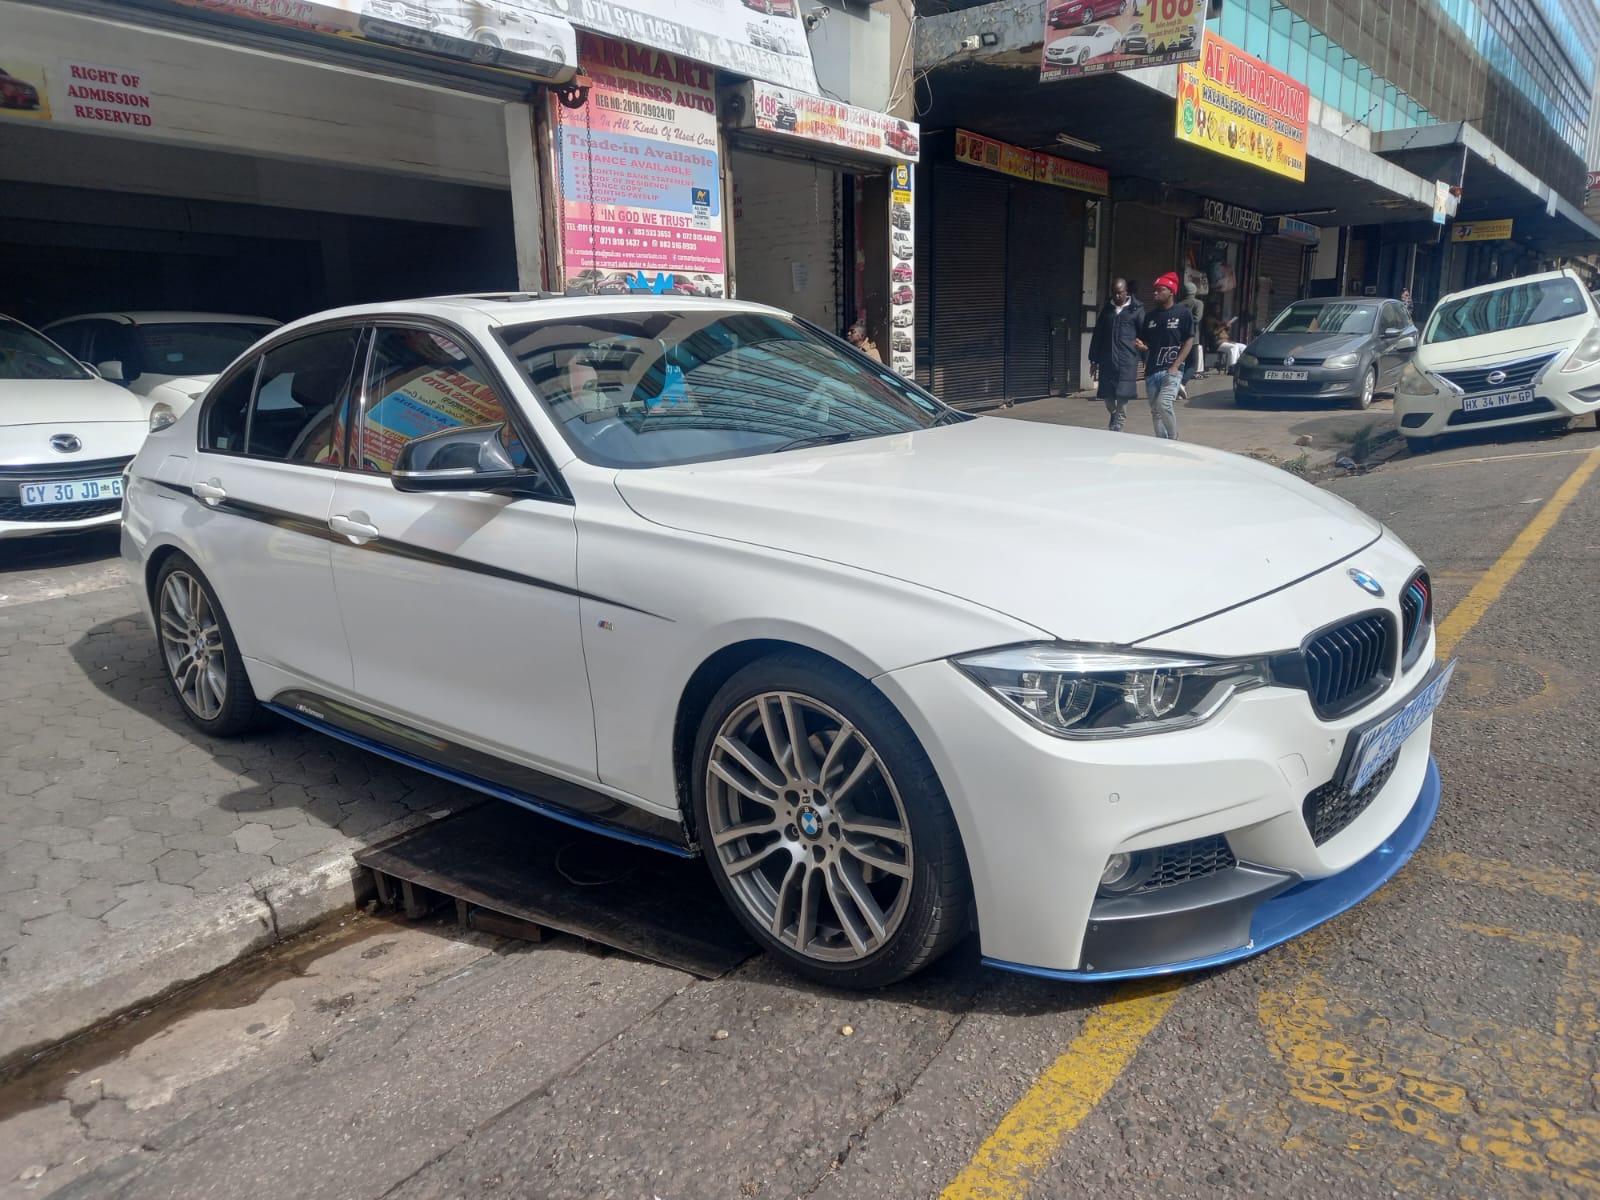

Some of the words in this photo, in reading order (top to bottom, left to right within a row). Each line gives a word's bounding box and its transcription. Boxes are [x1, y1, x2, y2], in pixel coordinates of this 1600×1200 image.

[613, 7, 645, 37] 910
[645, 17, 682, 44] 1437
[582, 36, 714, 90] ARMART
[1204, 41, 1224, 85] AL
[70, 65, 118, 84] RIGHT
[121, 74, 140, 88] OF
[67, 85, 150, 108] ADMISSION
[595, 94, 609, 108] REG
[610, 97, 621, 109] NO:
[675, 90, 714, 113] AUTO
[758, 94, 776, 115] 168
[74, 105, 152, 127] RESERVED
[1230, 98, 1246, 119] FOOD
[1246, 105, 1269, 126] CENTRE
[613, 117, 630, 131] All
[633, 120, 659, 136] Kinds
[661, 127, 672, 141] Of
[674, 129, 695, 143] Used
[697, 133, 715, 146] Cars
[567, 133, 640, 155] Trade-in
[644, 147, 714, 168] Available
[572, 151, 627, 167] FINANCE
[631, 159, 693, 177] AVAILABLE
[613, 176, 623, 184] OF
[625, 178, 669, 191] RESIDENCE
[621, 184, 642, 193] COPY
[651, 174, 695, 187] STATEMENT
[618, 210, 640, 223] GOD
[641, 213, 657, 225] WE
[1465, 399, 1478, 410] HX
[1482, 397, 1494, 408] 34
[1498, 394, 1511, 405] NY
[1518, 391, 1531, 402] GP
[26, 486, 45, 503] CY
[55, 484, 74, 500] 30
[81, 482, 100, 499] JD
[111, 480, 122, 496] G
